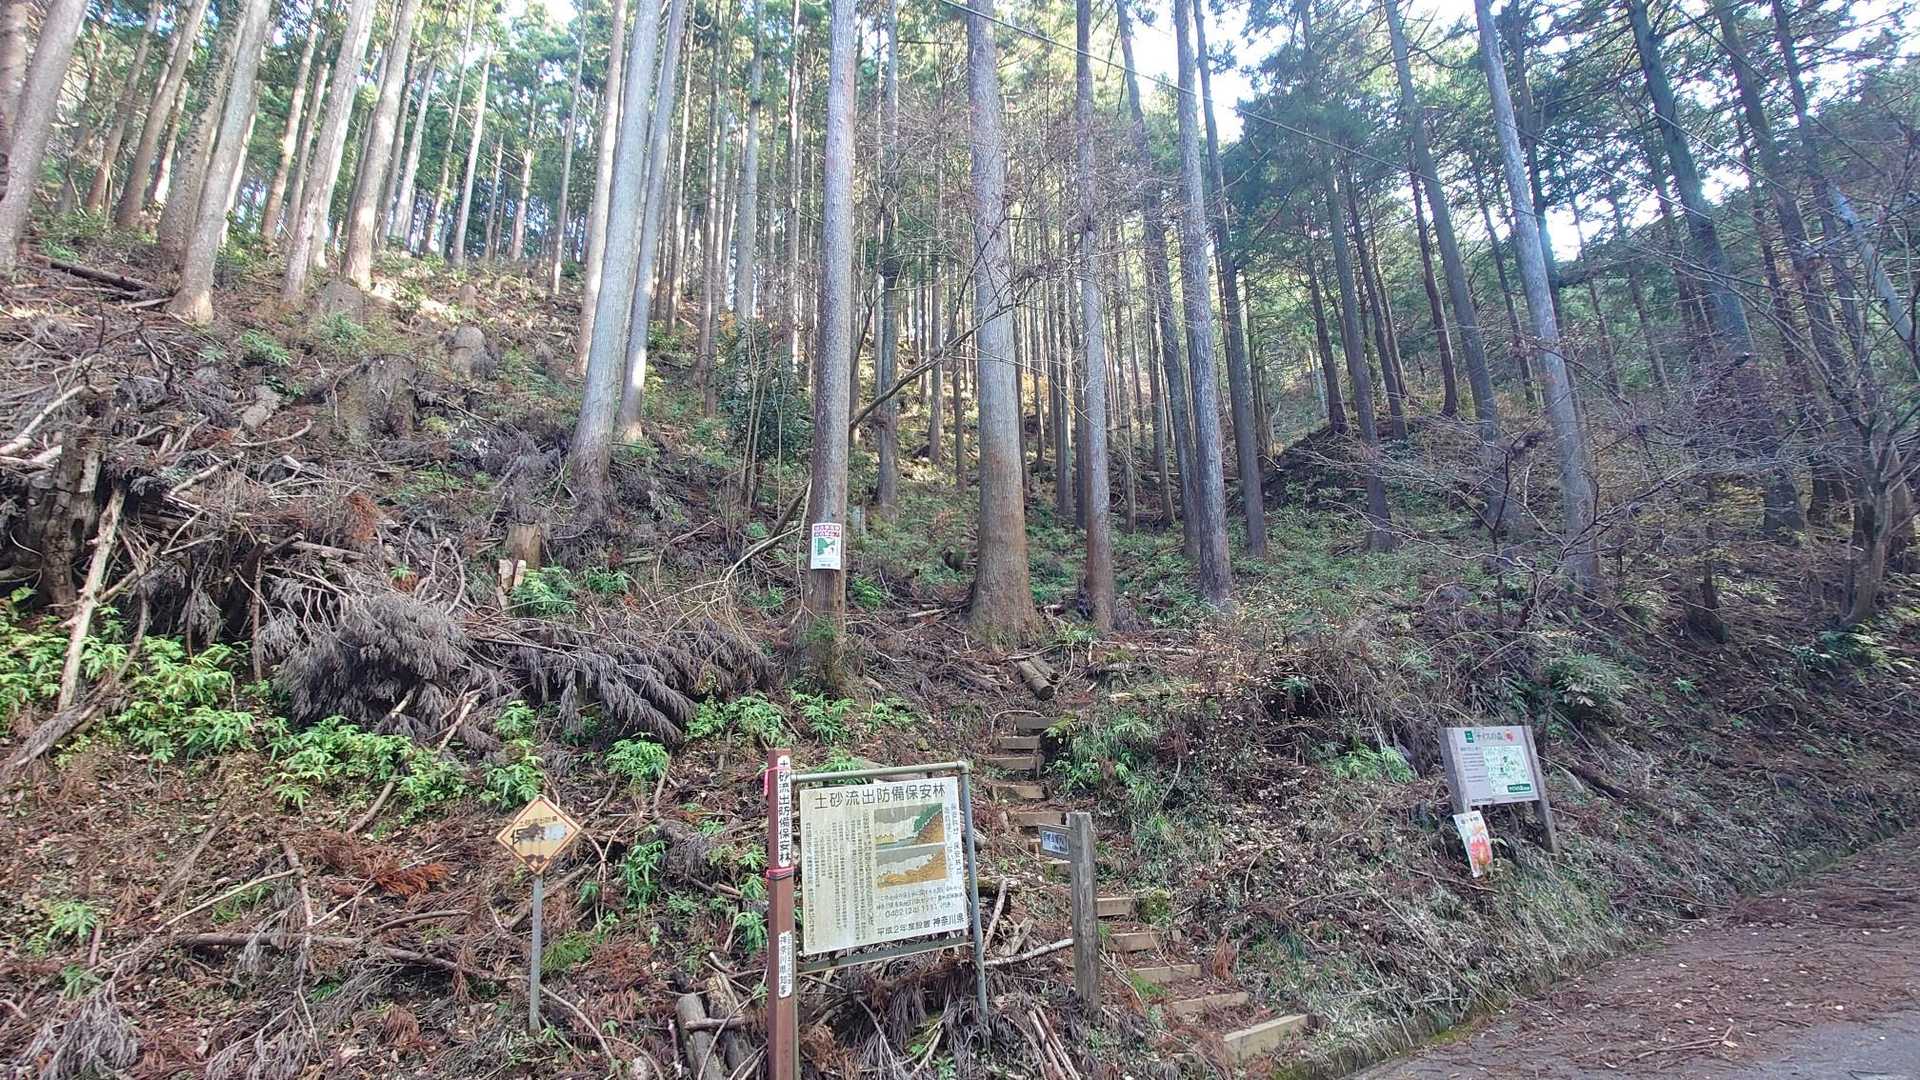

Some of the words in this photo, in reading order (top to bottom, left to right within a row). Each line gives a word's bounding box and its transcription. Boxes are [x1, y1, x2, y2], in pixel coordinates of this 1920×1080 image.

[814, 782, 946, 810] 土砂流出防備保安林
[779, 759, 791, 863] 土砂流出防備保安林
[932, 912, 965, 929] 神奈川県
